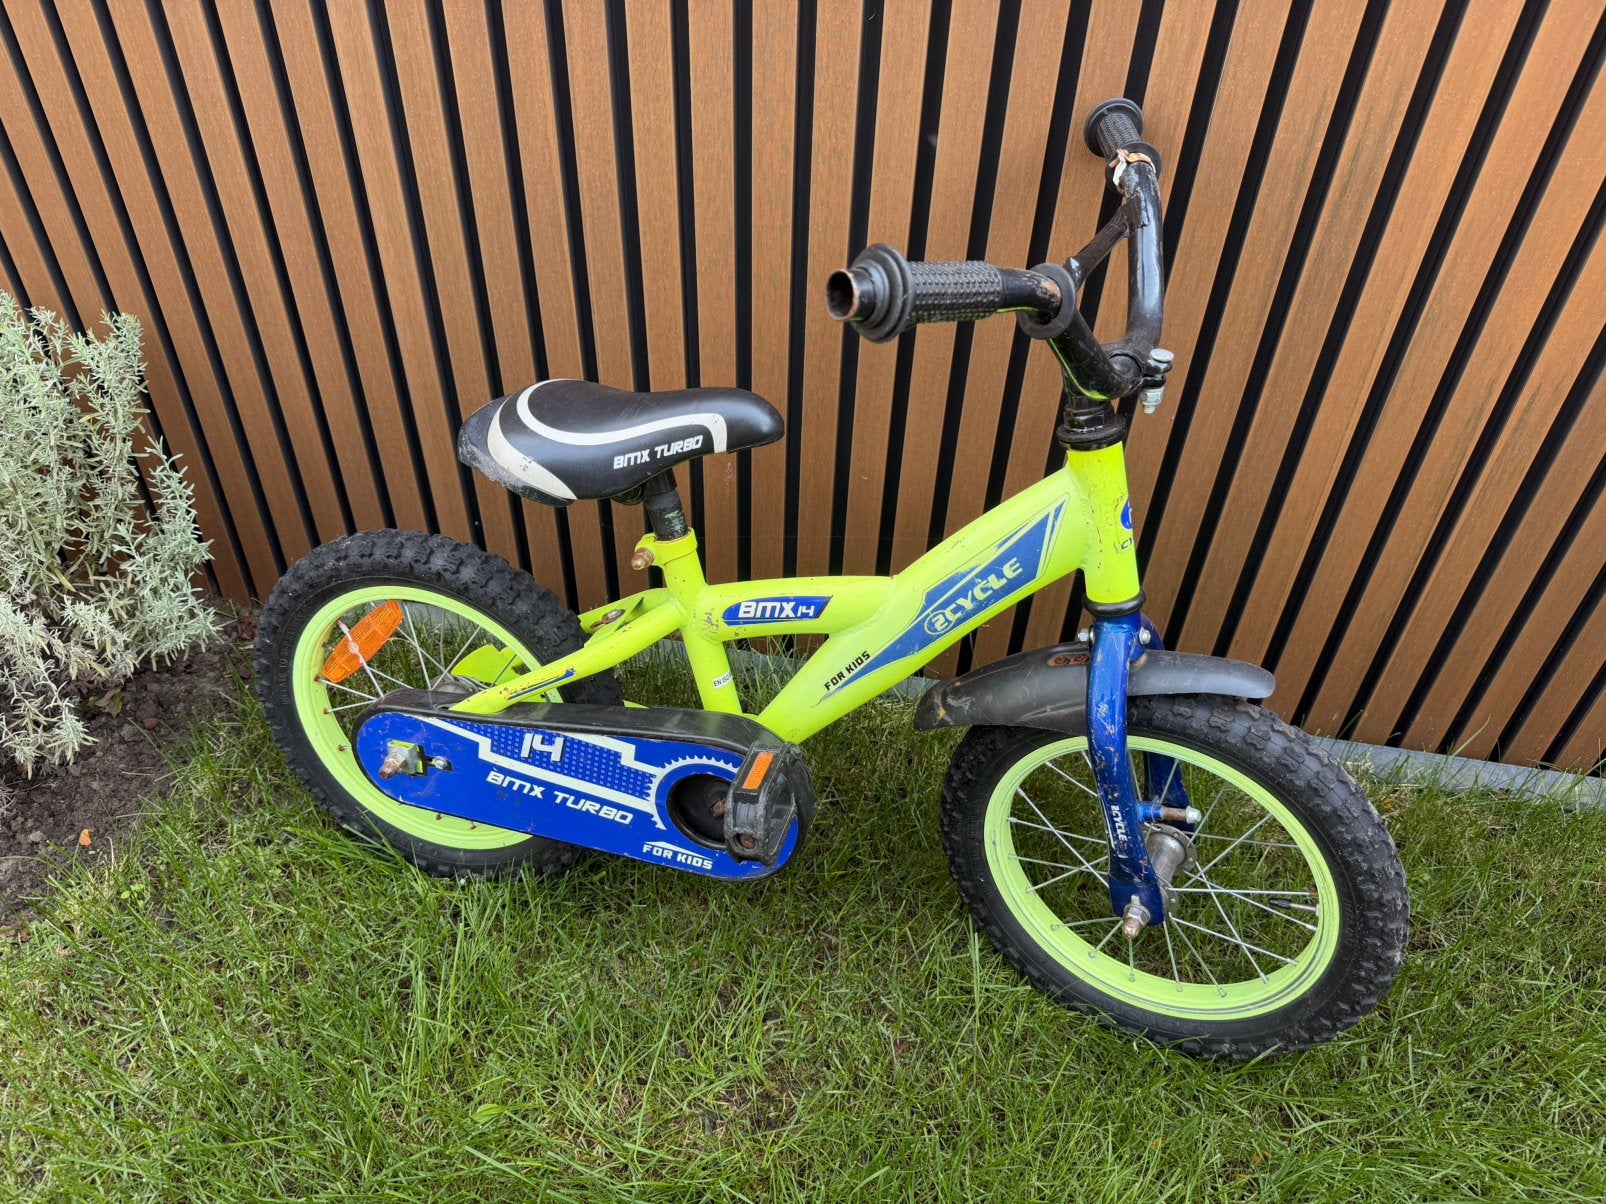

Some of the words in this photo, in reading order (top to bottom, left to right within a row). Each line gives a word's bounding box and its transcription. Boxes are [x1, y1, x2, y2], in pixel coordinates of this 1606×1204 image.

[613, 449, 650, 469] BMX
[655, 435, 703, 459] TURBO
[738, 601, 796, 618] BMX
[797, 605, 814, 616] 14
[824, 673, 846, 691] FOR
[845, 650, 871, 672] KIDS
[521, 733, 564, 762] 14
[486, 771, 546, 798] BMX
[553, 791, 634, 824] TURBO
[642, 843, 674, 860] FOR
[676, 852, 714, 870] KIDS
